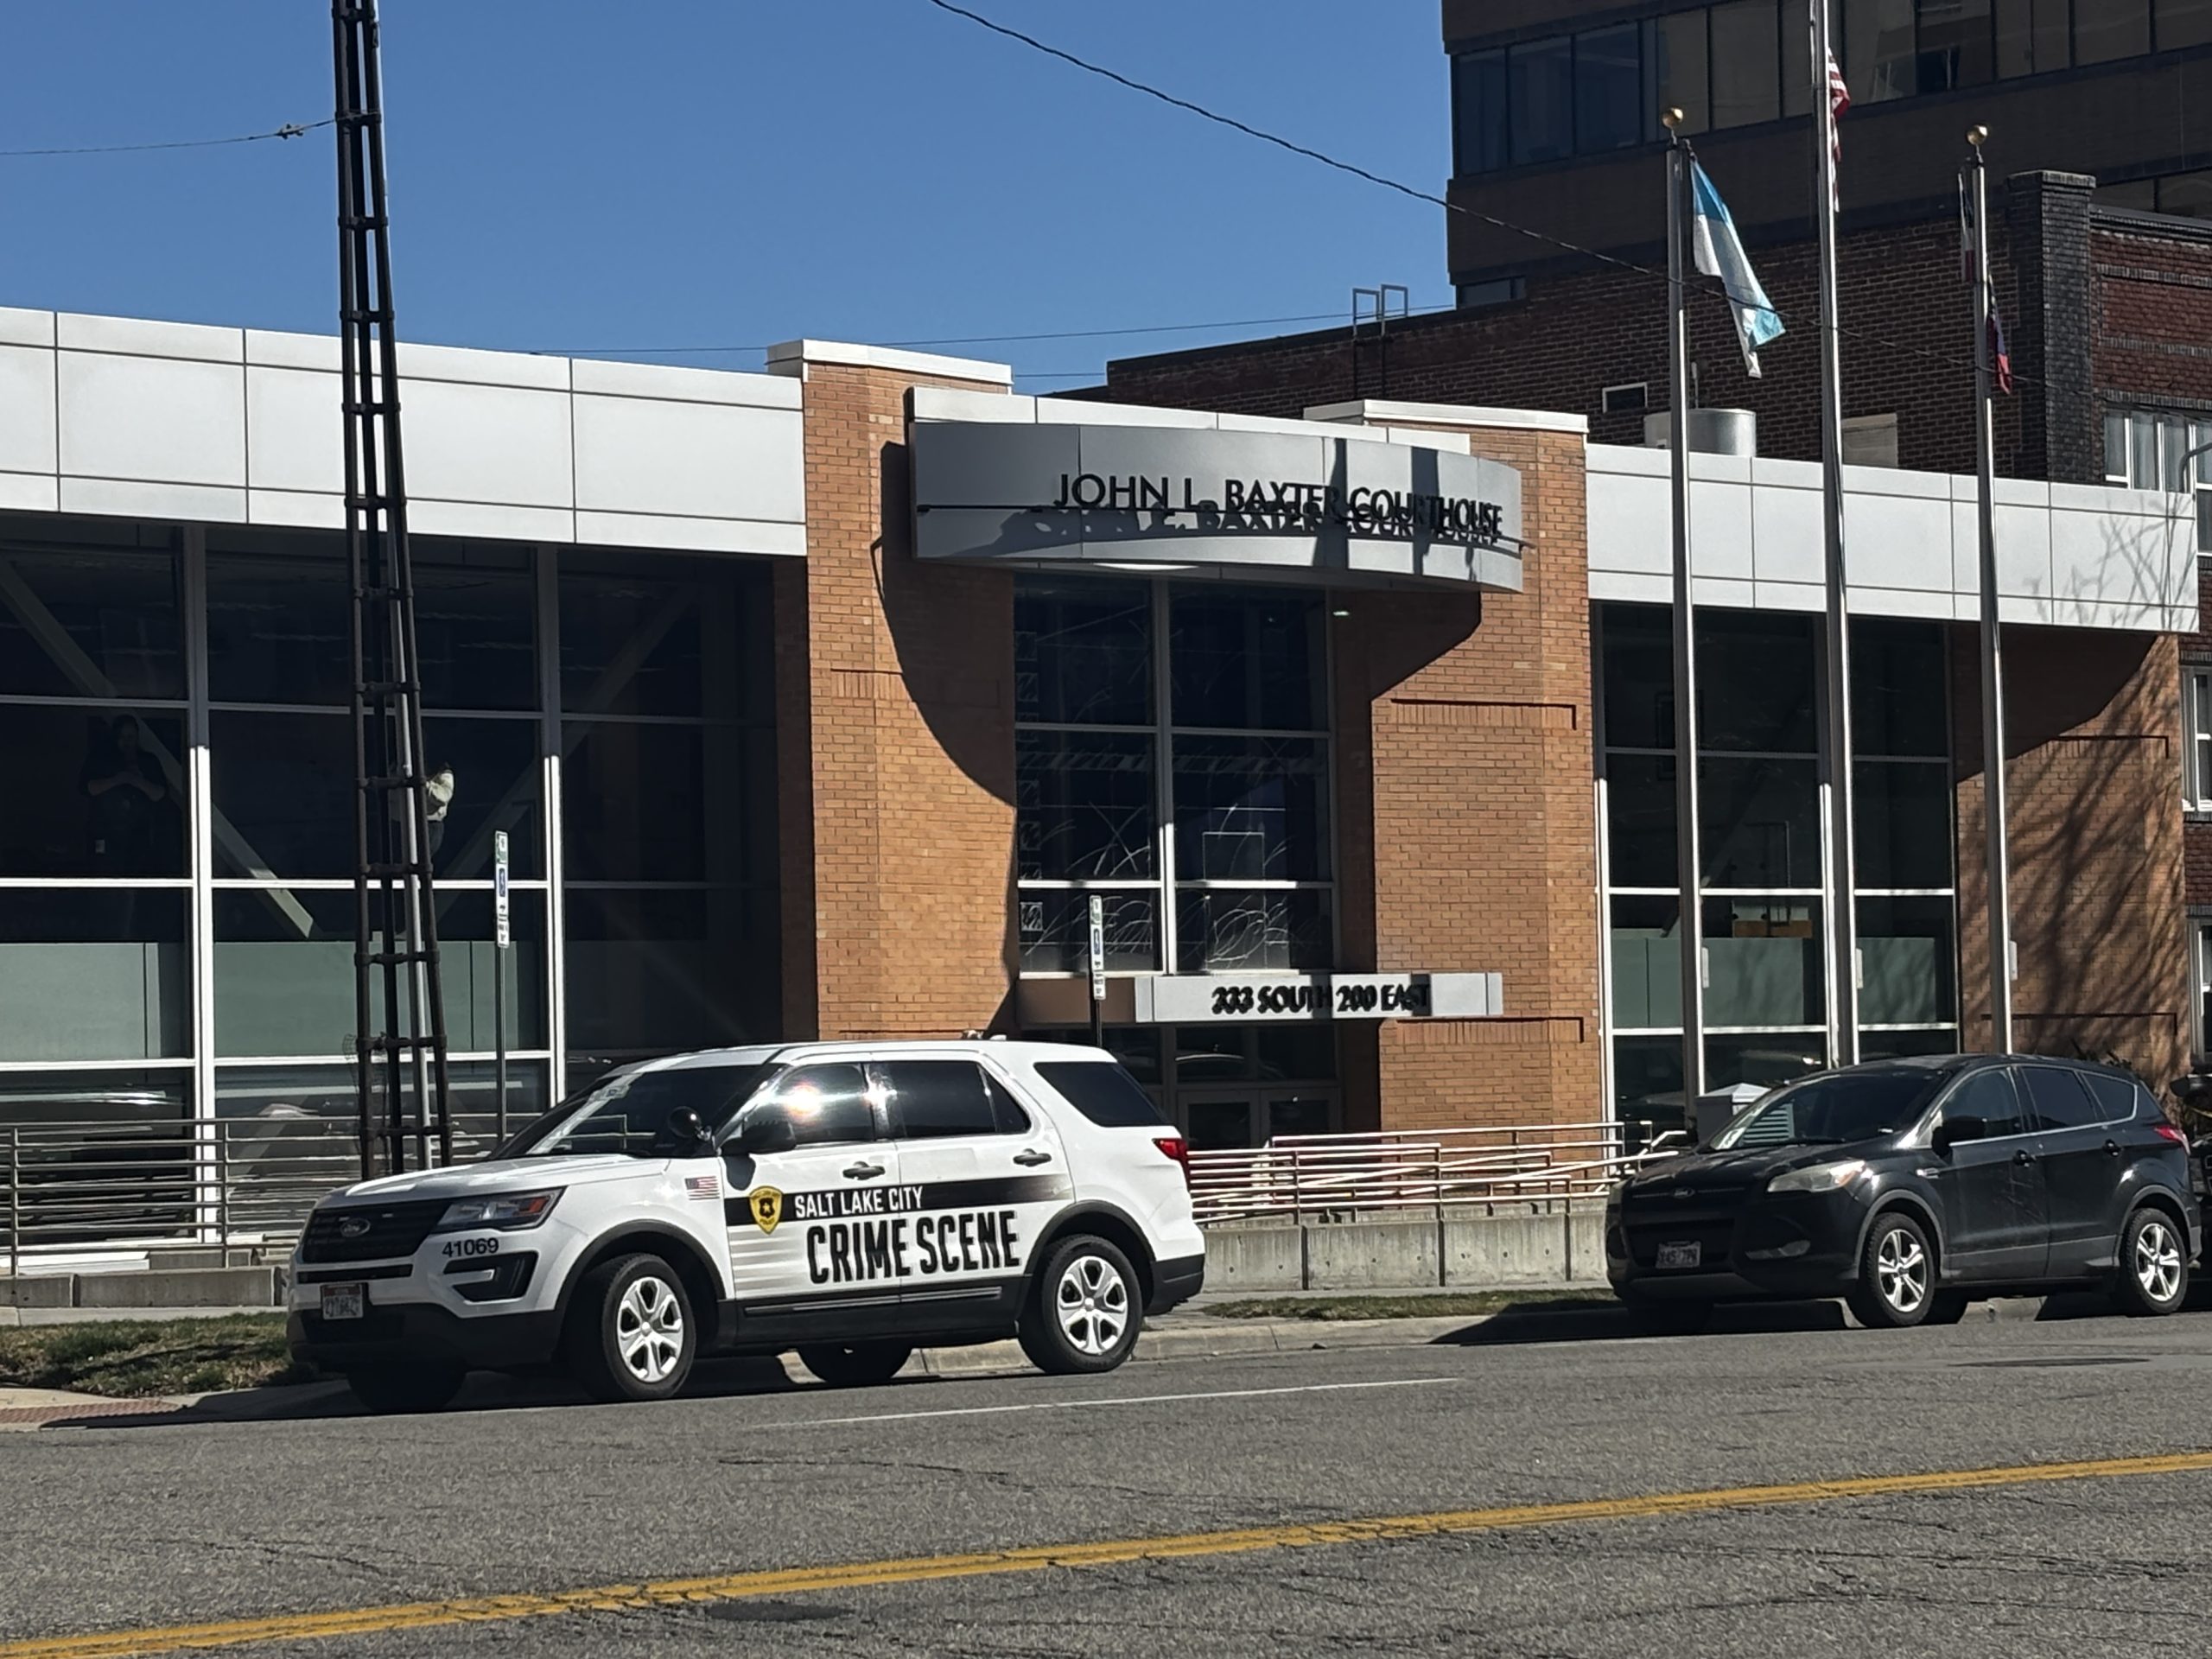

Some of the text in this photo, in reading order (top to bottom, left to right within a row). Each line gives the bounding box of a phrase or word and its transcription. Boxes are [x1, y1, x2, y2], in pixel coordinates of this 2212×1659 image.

[1053, 474, 1168, 510] JOHN
[1225, 480, 1342, 519] BAXTER
[1350, 487, 1503, 536] COURTHOUSE
[1257, 985, 1332, 1014] SOUTH
[1336, 985, 1377, 1012] 200
[1381, 984, 1429, 1011] EAST
[795, 1185, 923, 1218] SALT LAKE CITY
[442, 1237, 499, 1258] 41069
[807, 1211, 1020, 1285] CRIME SCENE
